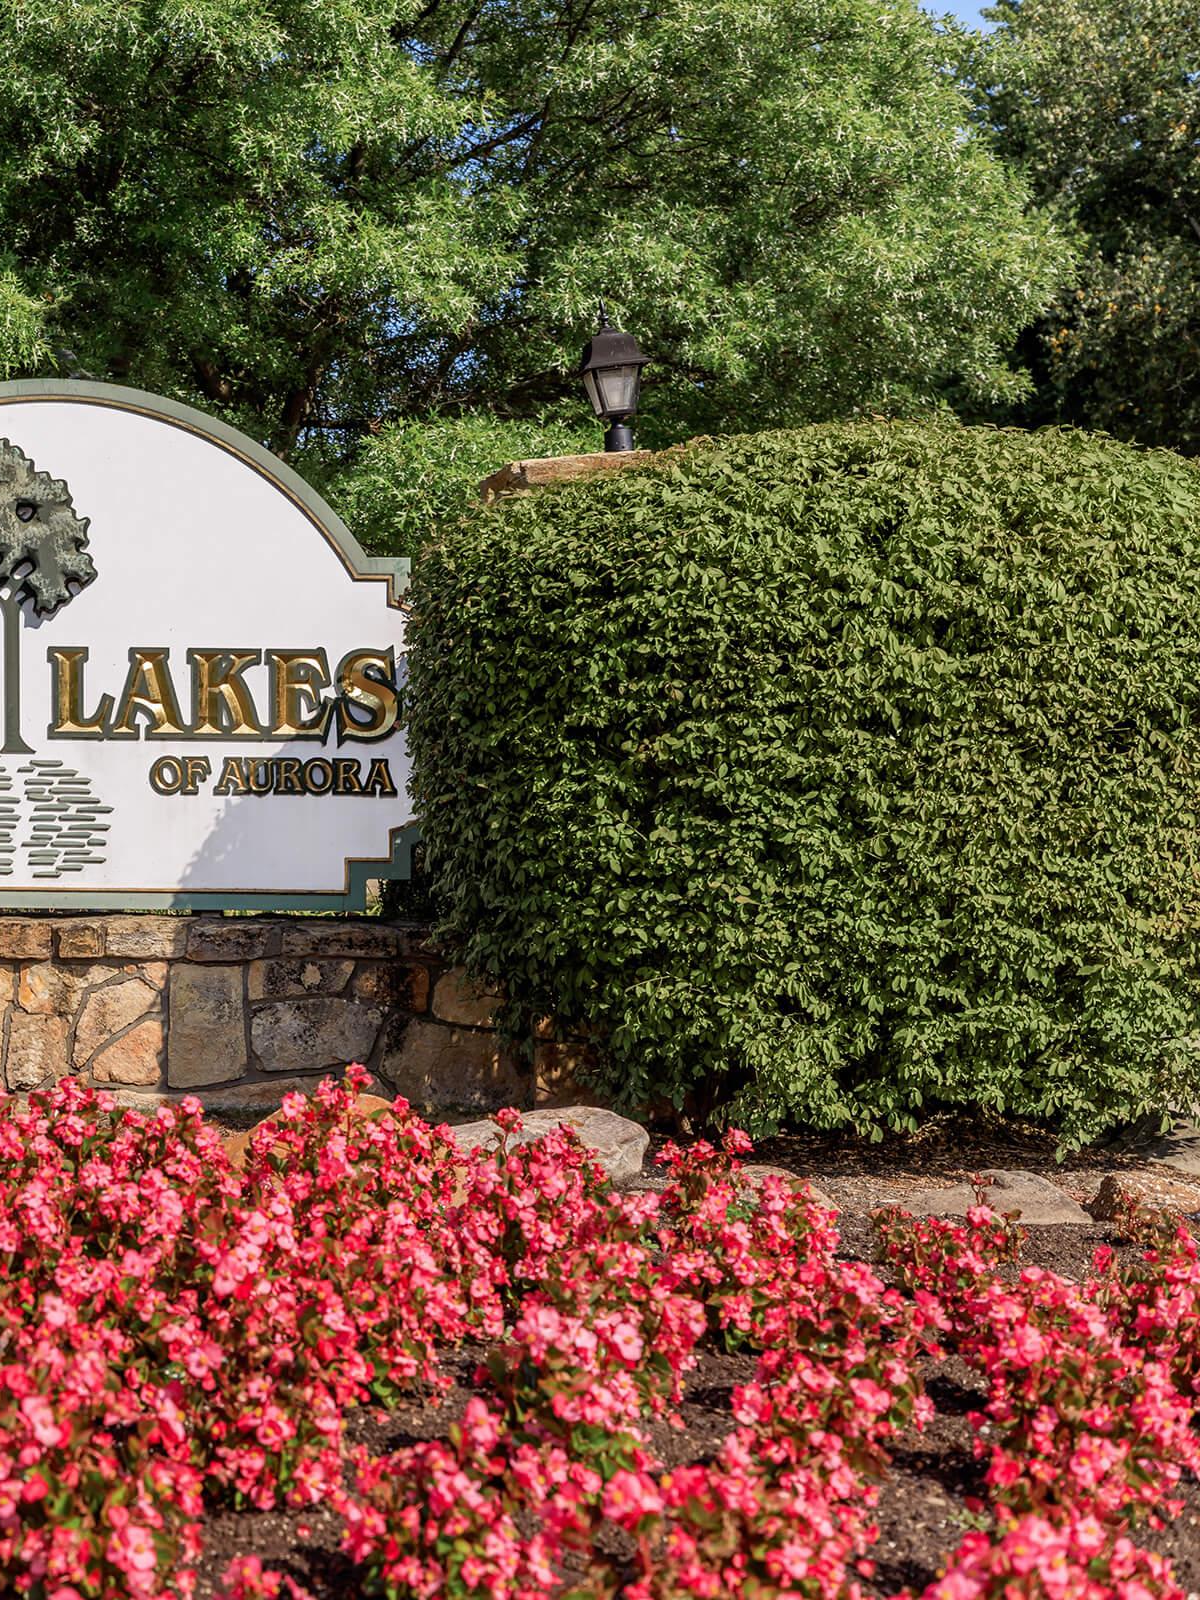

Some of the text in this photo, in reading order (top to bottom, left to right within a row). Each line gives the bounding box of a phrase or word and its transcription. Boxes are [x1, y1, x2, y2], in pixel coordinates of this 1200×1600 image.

[47, 645, 402, 748] LAKES
[149, 756, 397, 796] OF AURORA
